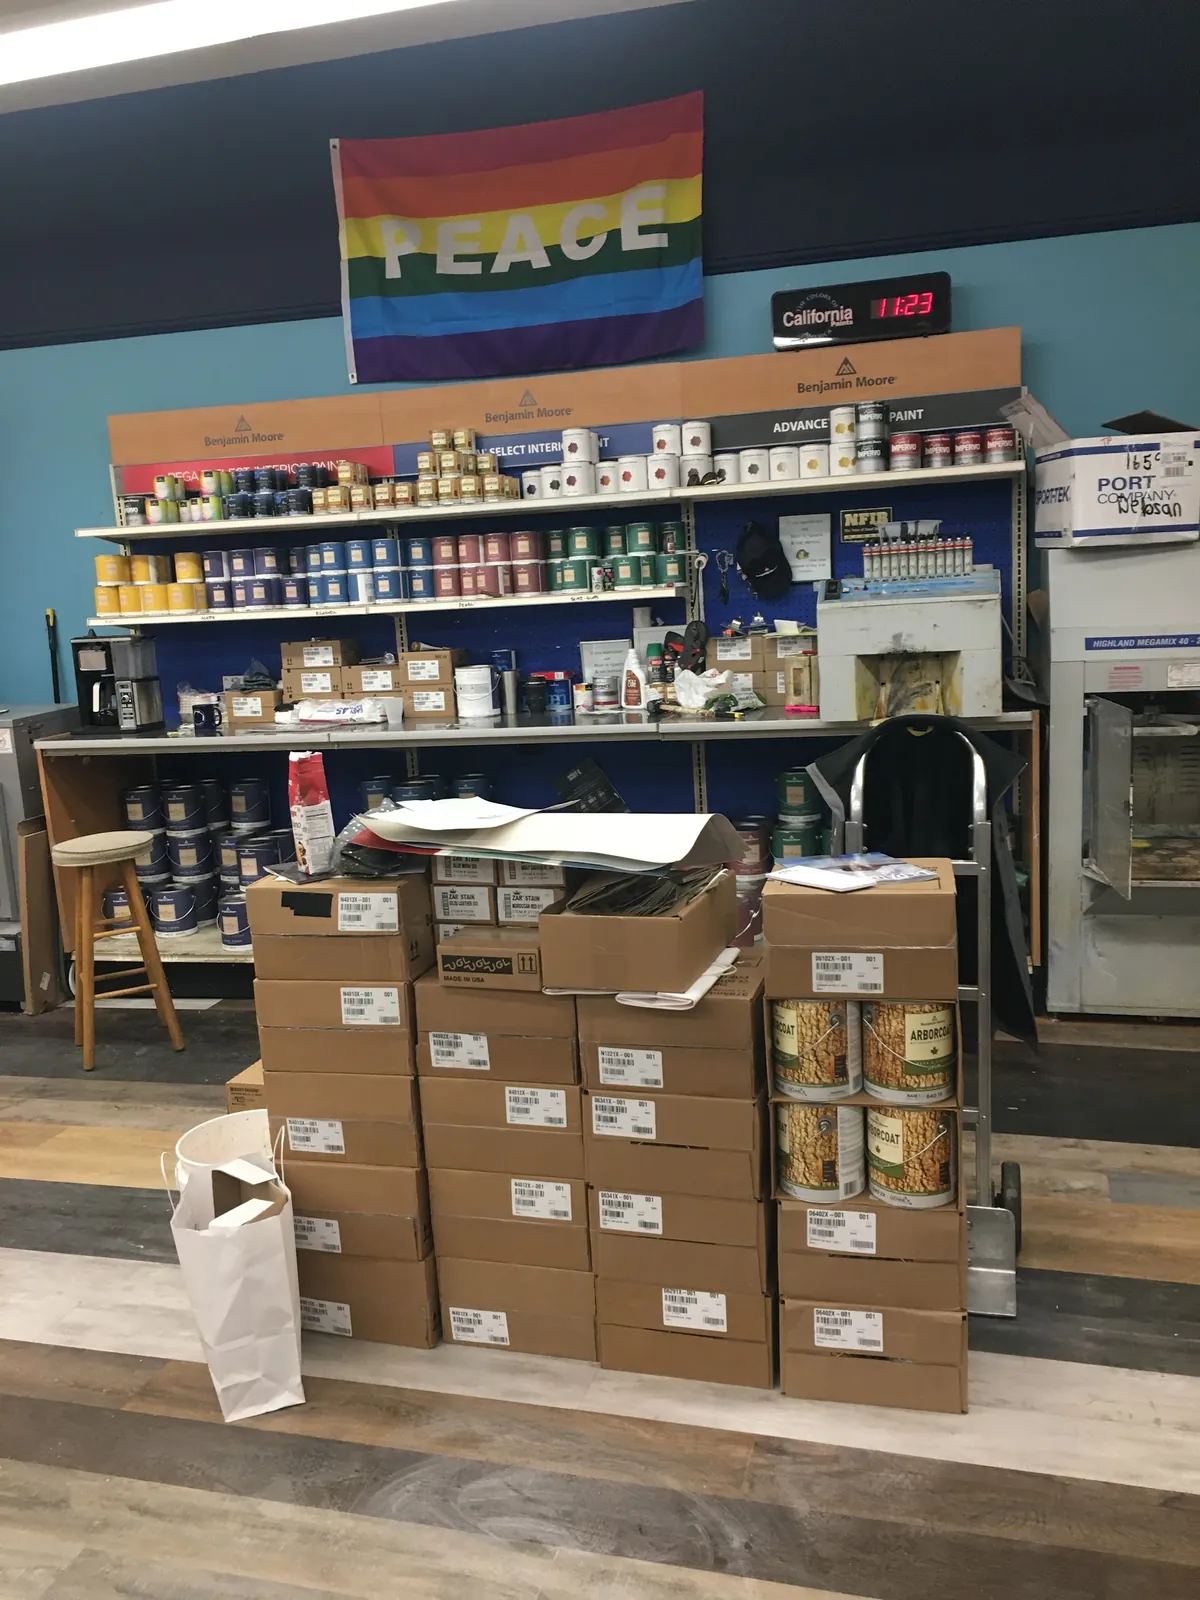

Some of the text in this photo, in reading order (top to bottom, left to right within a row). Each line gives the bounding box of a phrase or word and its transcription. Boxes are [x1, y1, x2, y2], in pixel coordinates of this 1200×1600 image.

[379, 185, 669, 280] PEACE
[879, 292, 934, 319] 11:23
[782, 305, 854, 327] California
[797, 374, 897, 395] Benjamin Moore
[484, 406, 573, 424] Benjamin Moore
[859, 413, 883, 422] IMPERVO
[772, 408, 925, 434] ADVANCE PAINT
[204, 432, 284, 448] Benjamin Moore
[987, 439, 1014, 449] IMPERVO
[891, 443, 917, 453] IMPERVO
[924, 446, 951, 456] IMPERVO
[954, 443, 981, 453] IMPERVO
[857, 449, 881, 458] IMPERVO
[1097, 475, 1157, 492] PORT
[1097, 489, 1175, 504] COMPANY
[844, 511, 889, 527] NFIB
[1093, 639, 1136, 648] HIGHLAND
[1137, 637, 1177, 647] MEGAMIX
[1178, 637, 1190, 645] 40
[382, 896, 392, 904] 001
[865, 955, 877, 963] 001
[383, 990, 393, 998] 001
[549, 1091, 559, 1099] 001
[638, 1100, 648, 1108] 001
[644, 1195, 655, 1203] 001
[858, 1212, 870, 1221] 001
[709, 1291, 720, 1299] 001
[492, 1313, 501, 1321] 001
[865, 1312, 876, 1320] 001
